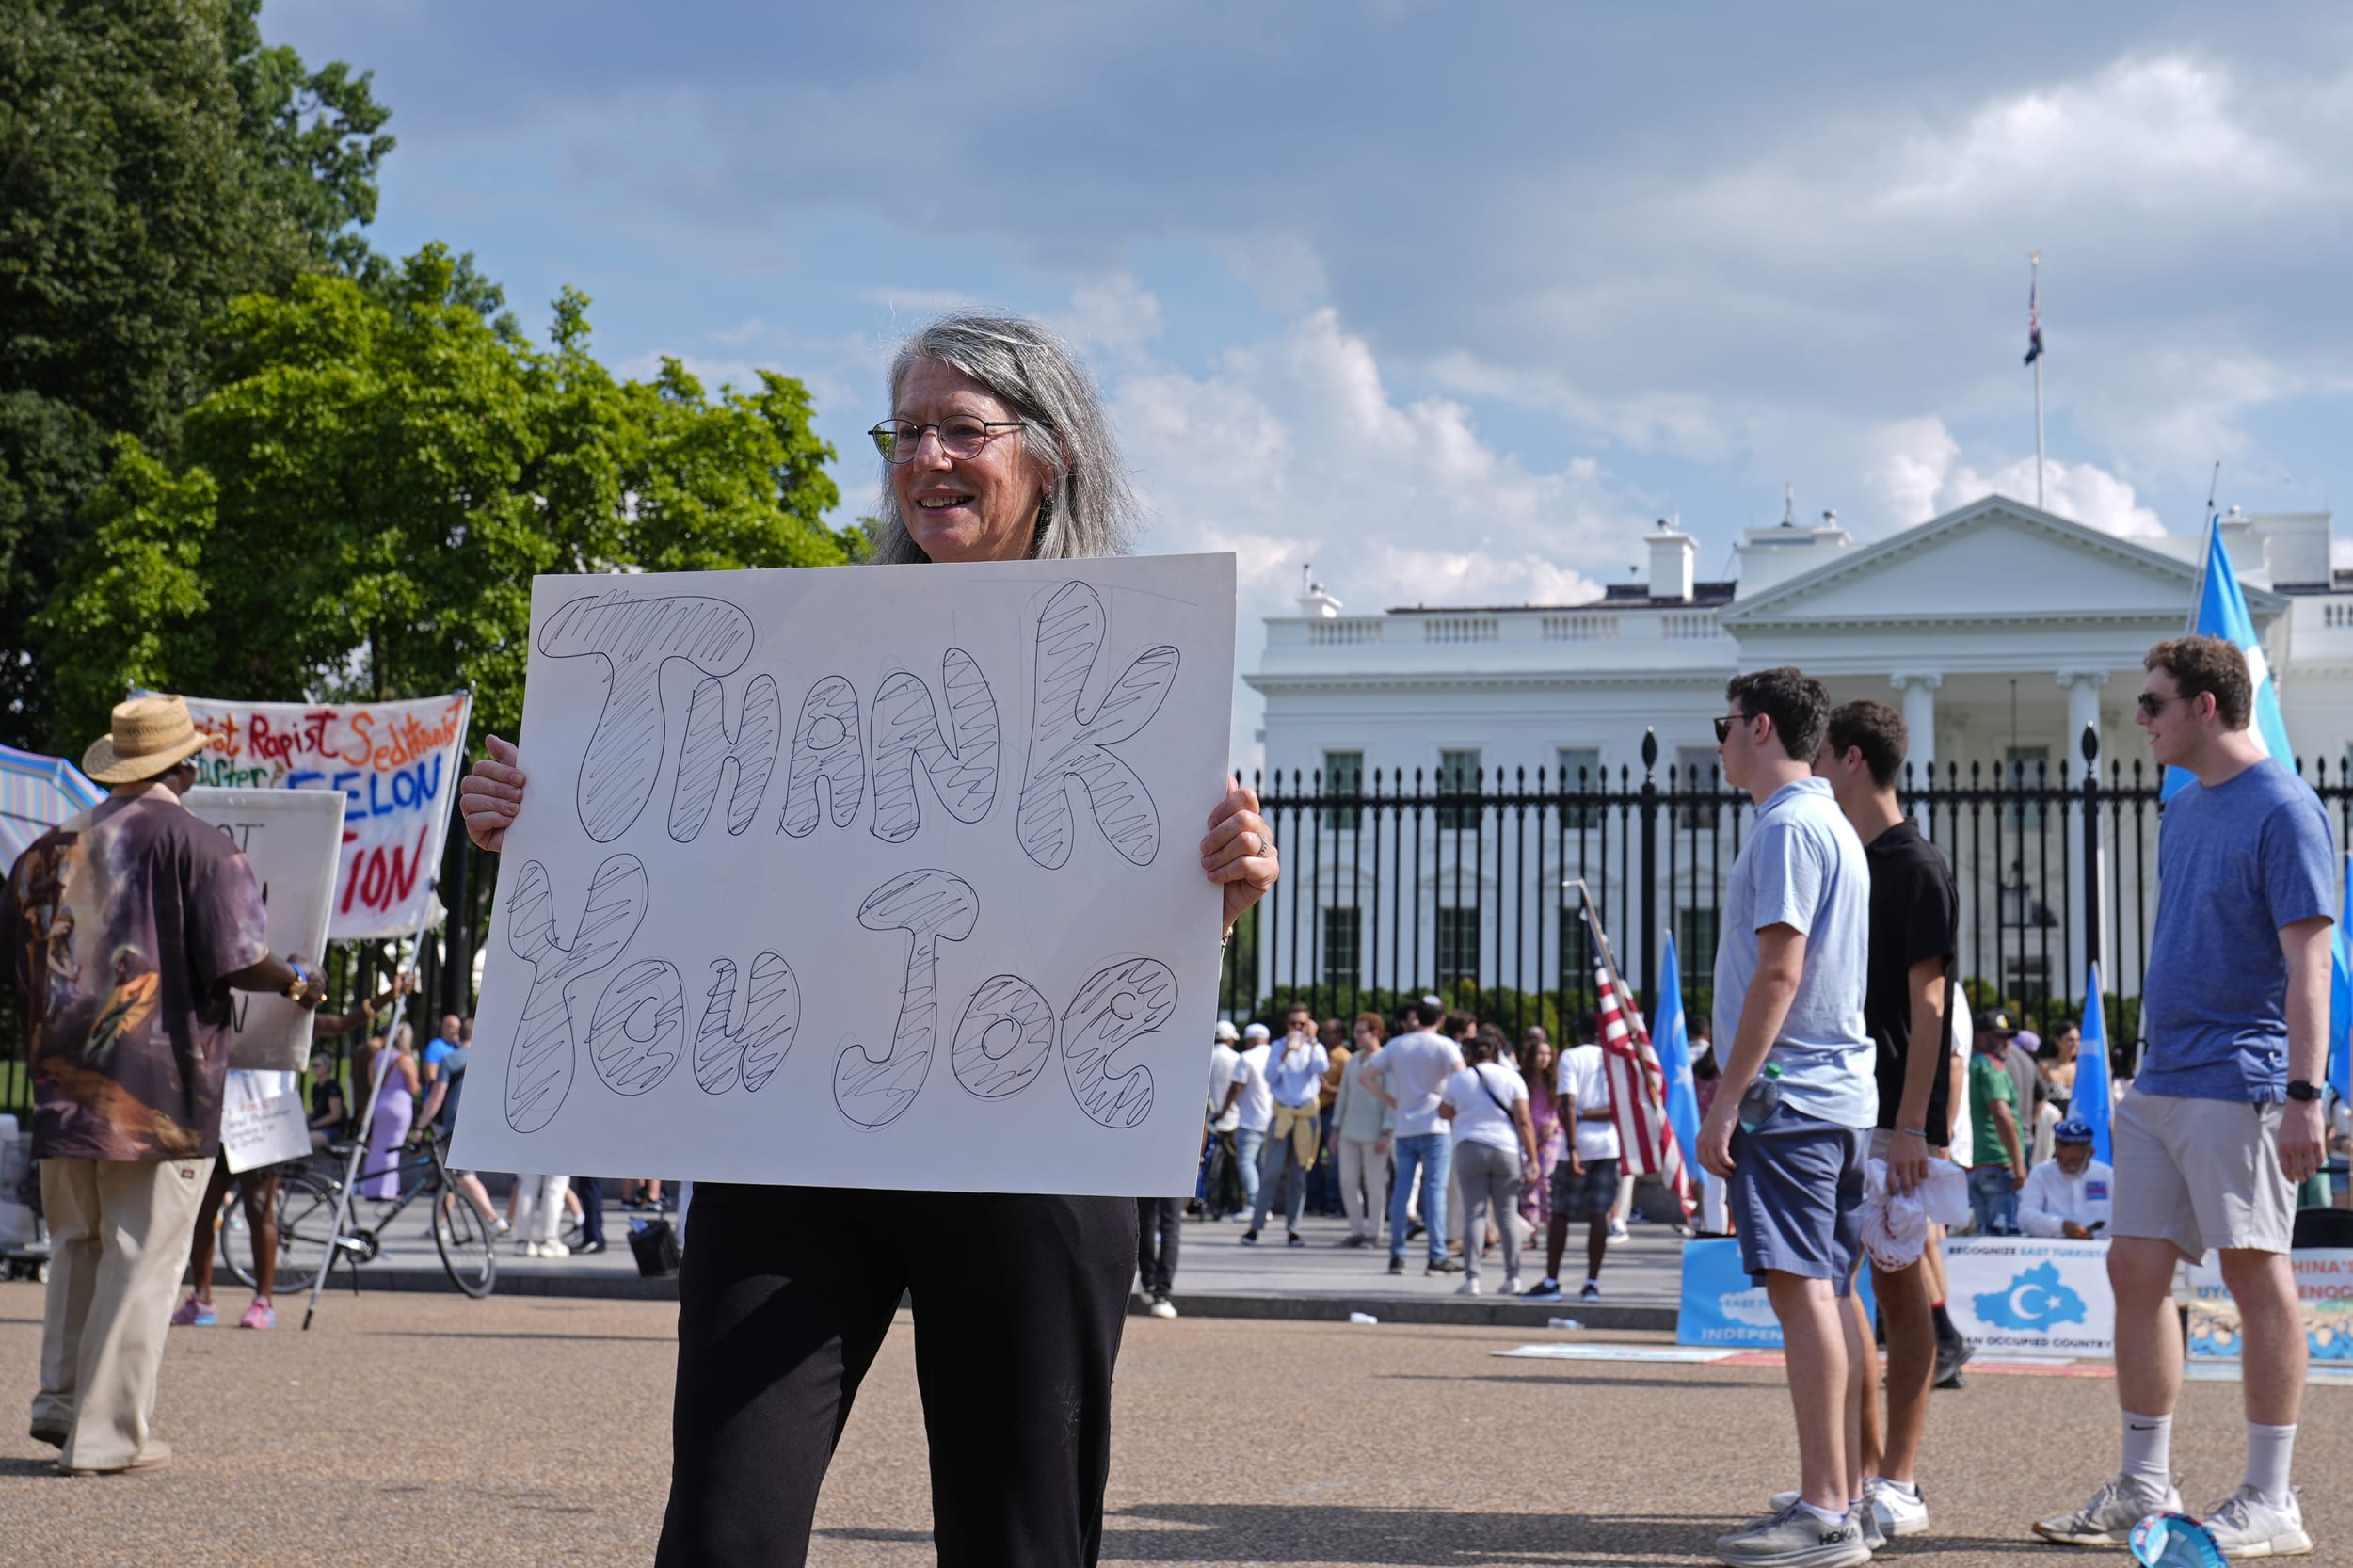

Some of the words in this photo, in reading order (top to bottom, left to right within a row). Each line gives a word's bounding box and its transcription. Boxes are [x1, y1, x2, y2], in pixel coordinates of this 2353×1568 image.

[249, 711, 340, 769] Rapist
[1948, 1245, 2016, 1256] RECOGNIZE
[2020, 1246, 2049, 1256] EAST
[1702, 1327, 1785, 1341] INDEPEN
[1986, 1336, 2049, 1348] OCCUPIED
[2053, 1337, 2111, 1349] COUNTRY
[1818, 1527, 1858, 1545] HOKA
